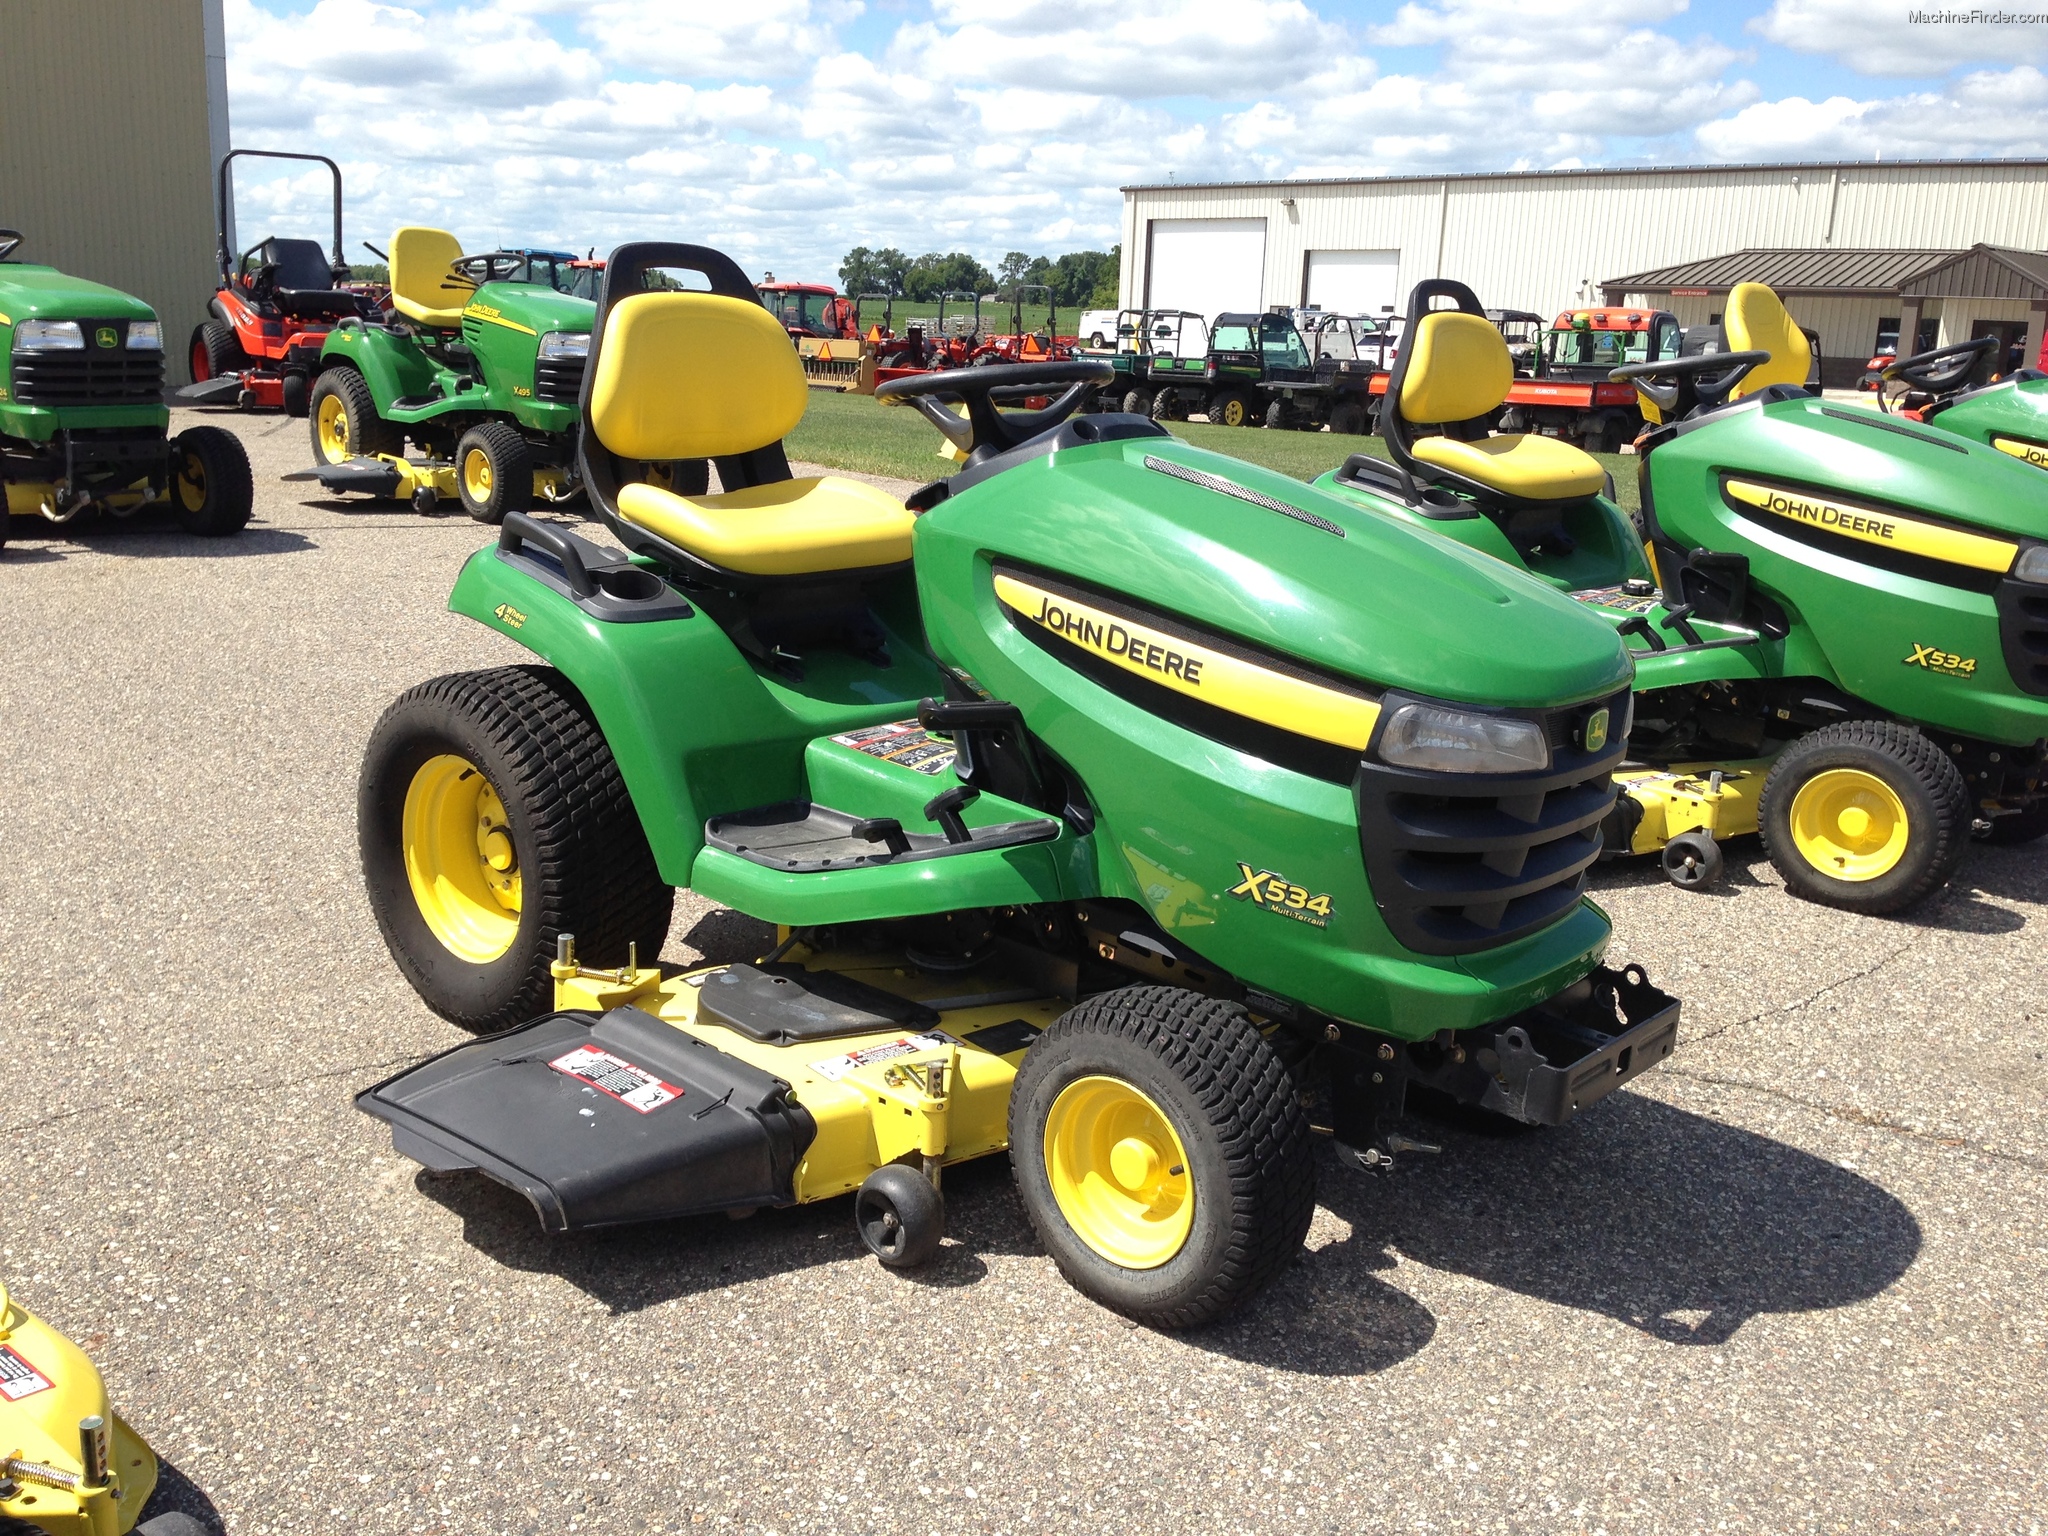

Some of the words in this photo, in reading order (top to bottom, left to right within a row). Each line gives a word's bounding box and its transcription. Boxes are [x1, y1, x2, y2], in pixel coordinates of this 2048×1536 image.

[513, 385, 531, 397] X495
[1535, 388, 1558, 396] KUBOTA
[1760, 492, 1819, 522] JOHN
[1821, 505, 1896, 540] DEERE
[493, 603, 507, 619] 4
[506, 605, 528, 623] Wheel
[502, 613, 523, 629] Steer
[1033, 597, 1103, 650] JOHN
[1106, 623, 1203, 687] DEERE
[1904, 642, 1977, 673] X534
[1230, 863, 1332, 918] X534
